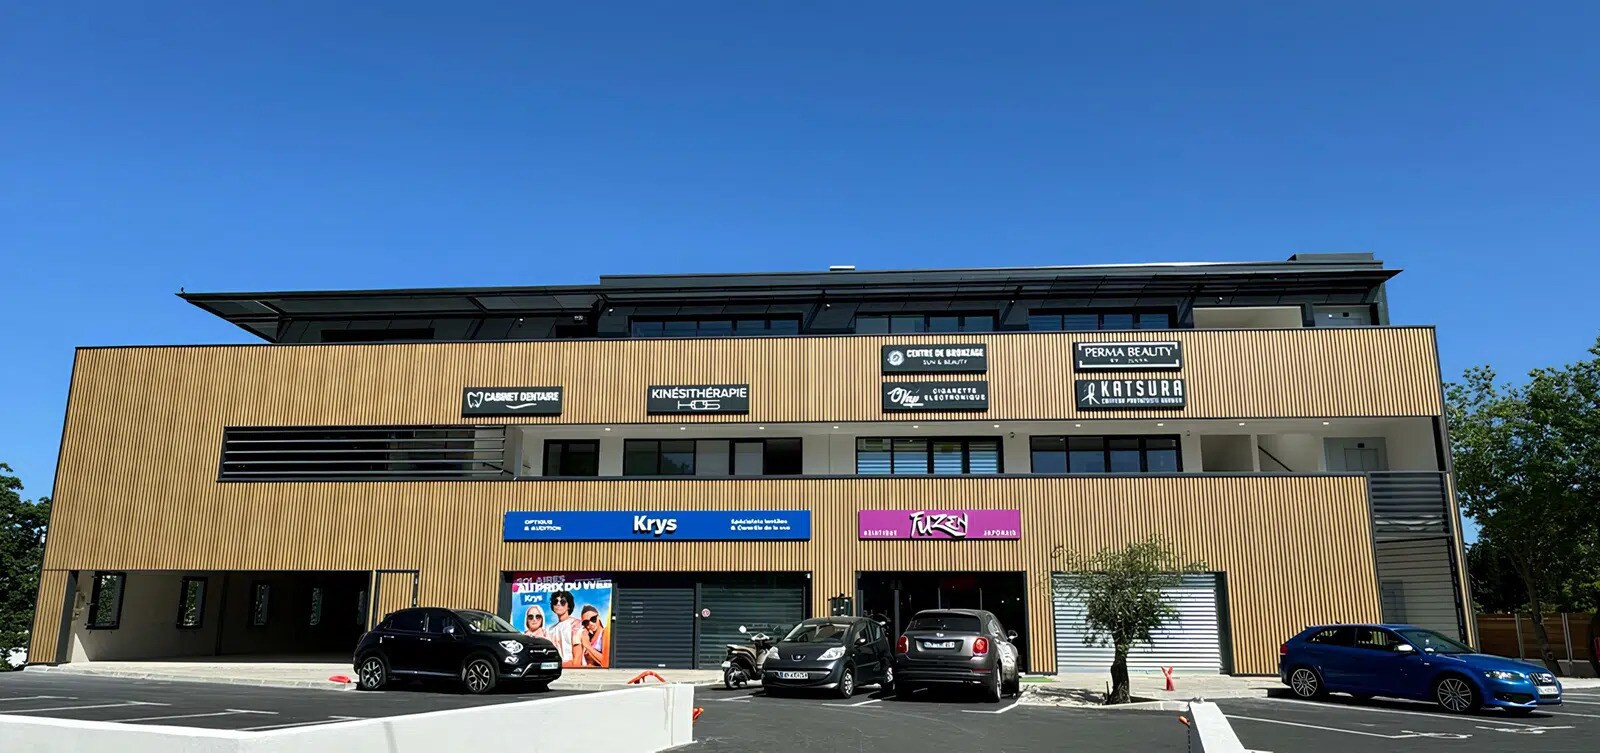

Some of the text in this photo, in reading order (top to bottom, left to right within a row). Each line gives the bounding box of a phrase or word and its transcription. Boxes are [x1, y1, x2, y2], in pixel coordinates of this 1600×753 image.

[1084, 346, 1173, 357] PERMA BEAUTY
[651, 386, 748, 399] KINÉSITHÉRAPIE
[1100, 380, 1183, 397] KATSURA
[484, 391, 560, 402] CABINET DENTAIRE
[634, 515, 678, 535] Krys
[910, 510, 969, 538] FUZEN
[564, 581, 582, 591] DU
[524, 594, 543, 603] Krys
